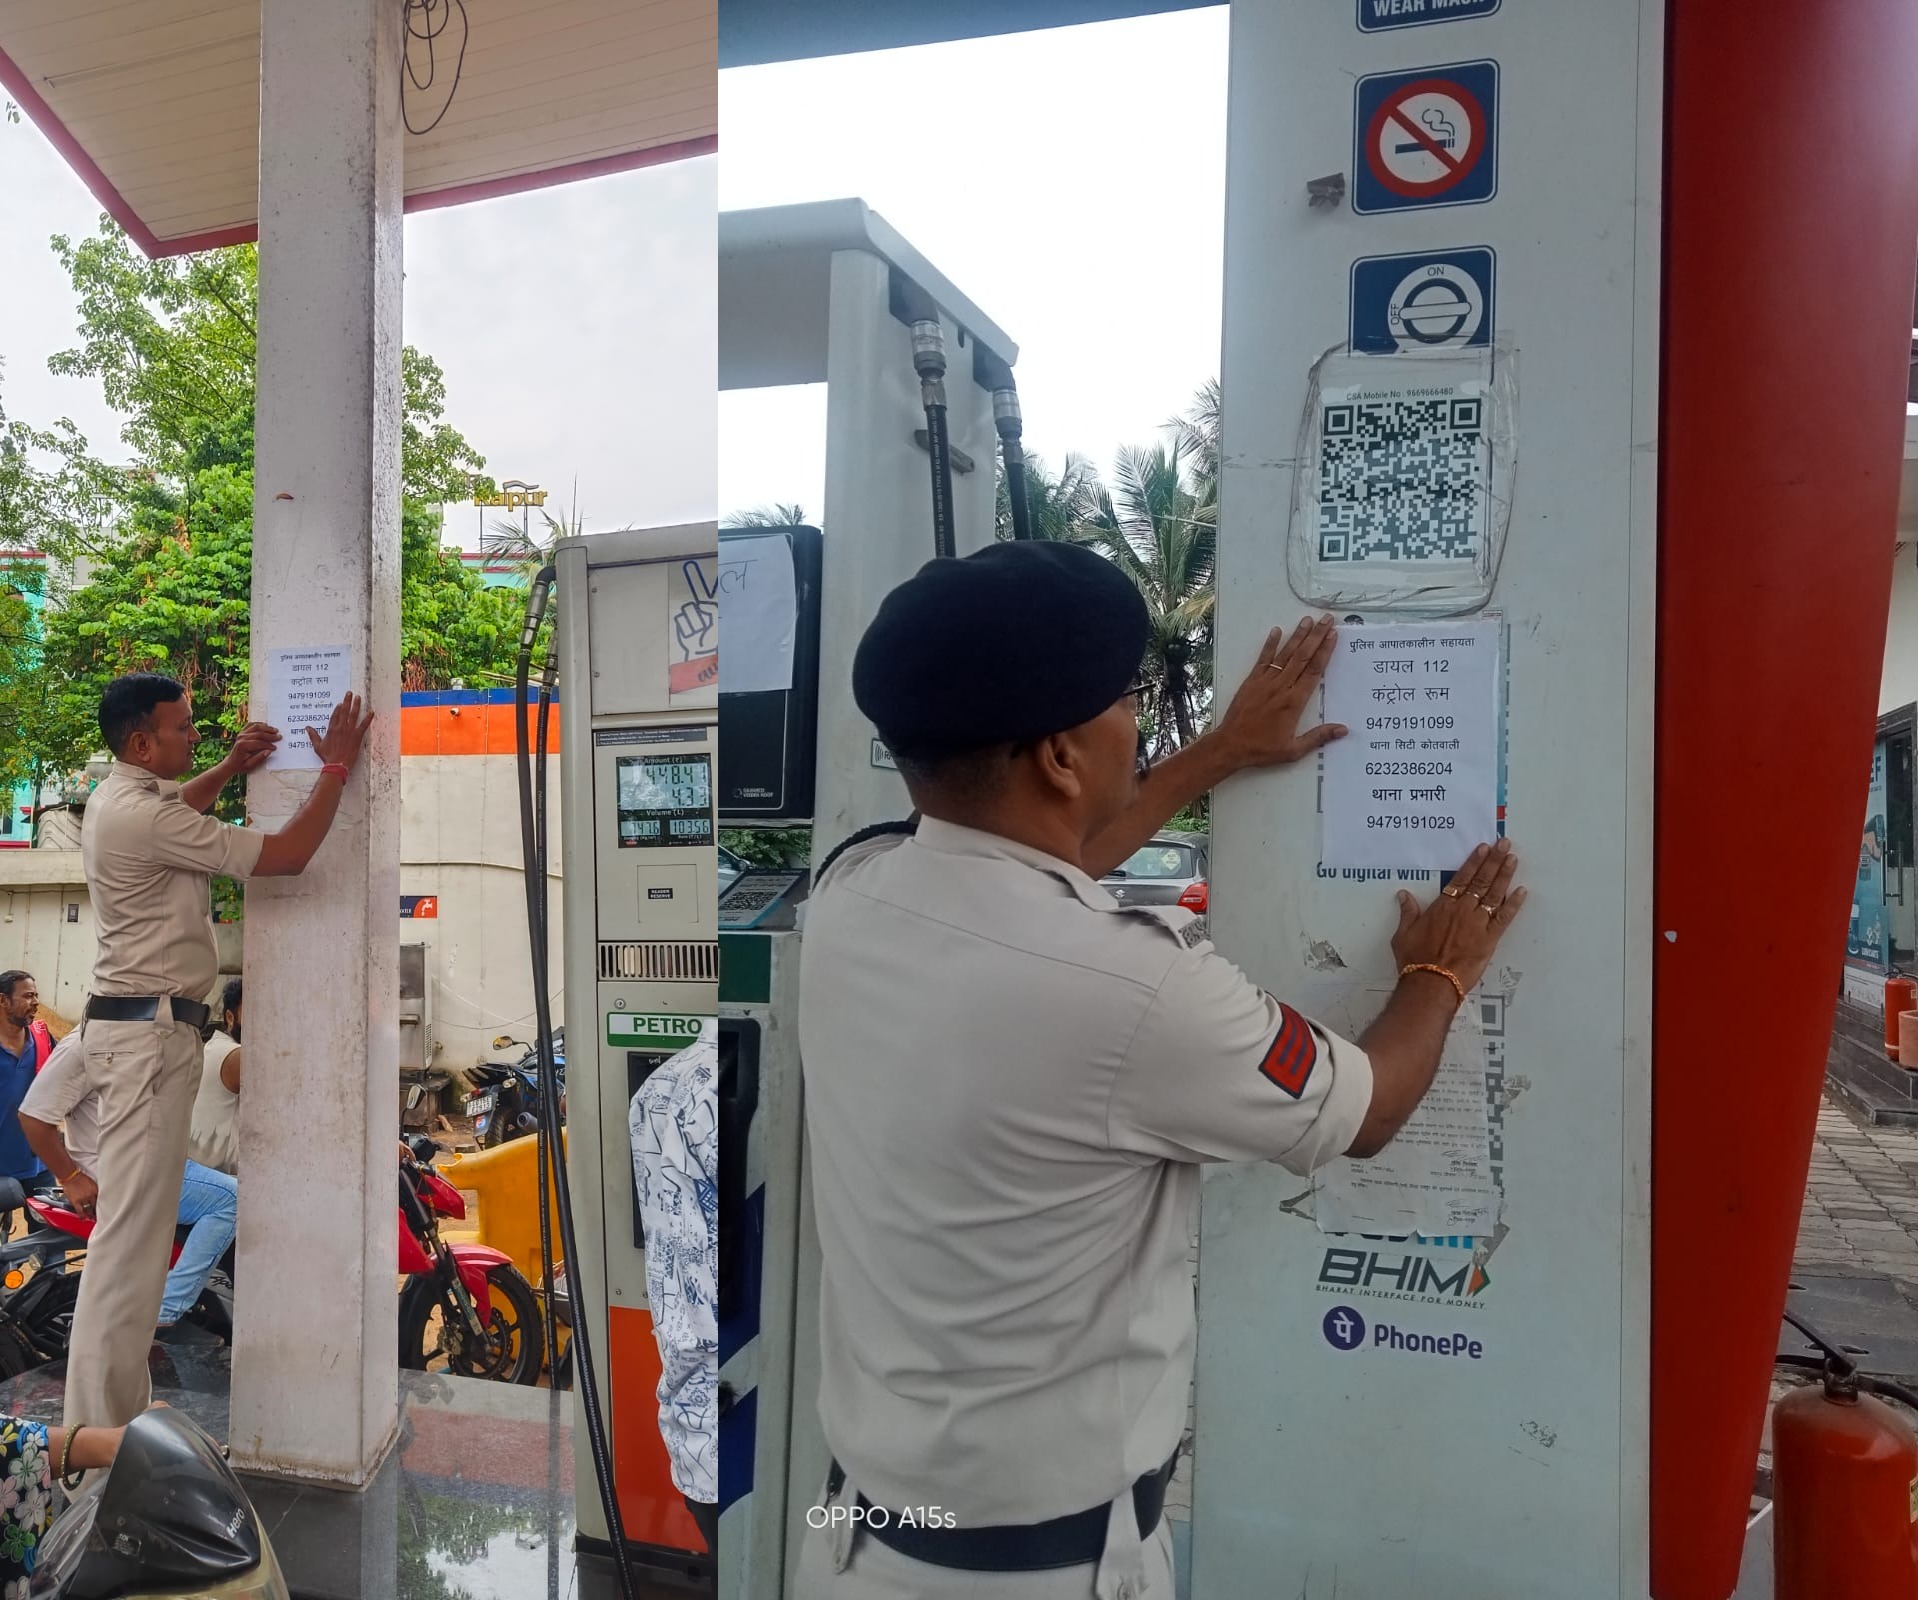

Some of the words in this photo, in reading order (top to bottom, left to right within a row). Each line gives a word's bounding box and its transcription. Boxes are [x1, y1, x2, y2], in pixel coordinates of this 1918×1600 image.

[1373, 0, 1425, 17] WEAR
[1427, 266, 1445, 277] ON
[1390, 303, 1400, 326] OFF
[1363, 388, 1389, 400] Mobile
[1406, 387, 1454, 398] 9669666480
[1350, 638, 1375, 653] पुलिस
[1379, 638, 1435, 649] आपातकालीन
[1440, 637, 1475, 648] सहायता
[1373, 659, 1414, 674] डायल
[1423, 659, 1450, 673] 112
[288, 691, 331, 700] 9479191099
[1371, 683, 1416, 705] कंट्रोल
[1424, 686, 1451, 701] रूम
[287, 714, 330, 723] 6232386204
[1366, 716, 1454, 730] 9479191099
[1369, 740, 1390, 750] थाना
[1395, 738, 1416, 750] सिटी
[1420, 738, 1460, 750] कोतवाली
[1365, 762, 1453, 776] 6232386204
[1372, 788, 1402, 801] थाना
[1409, 785, 1447, 802] प्रभारी
[646, 809, 672, 817] Volume
[1367, 815, 1455, 830] 9479191029
[632, 1016, 703, 1034] PETRO
[1318, 1248, 1471, 1297] BHIM
[1315, 1284, 1355, 1295] BHARAT
[1359, 1288, 1415, 1302] INTERFACE
[1420, 1295, 1442, 1305] FOR
[1445, 1297, 1486, 1309] MONEY
[1333, 1311, 1355, 1344] पे
[1374, 1323, 1483, 1360] PhonePe
[226, 1508, 245, 1538] Hero
